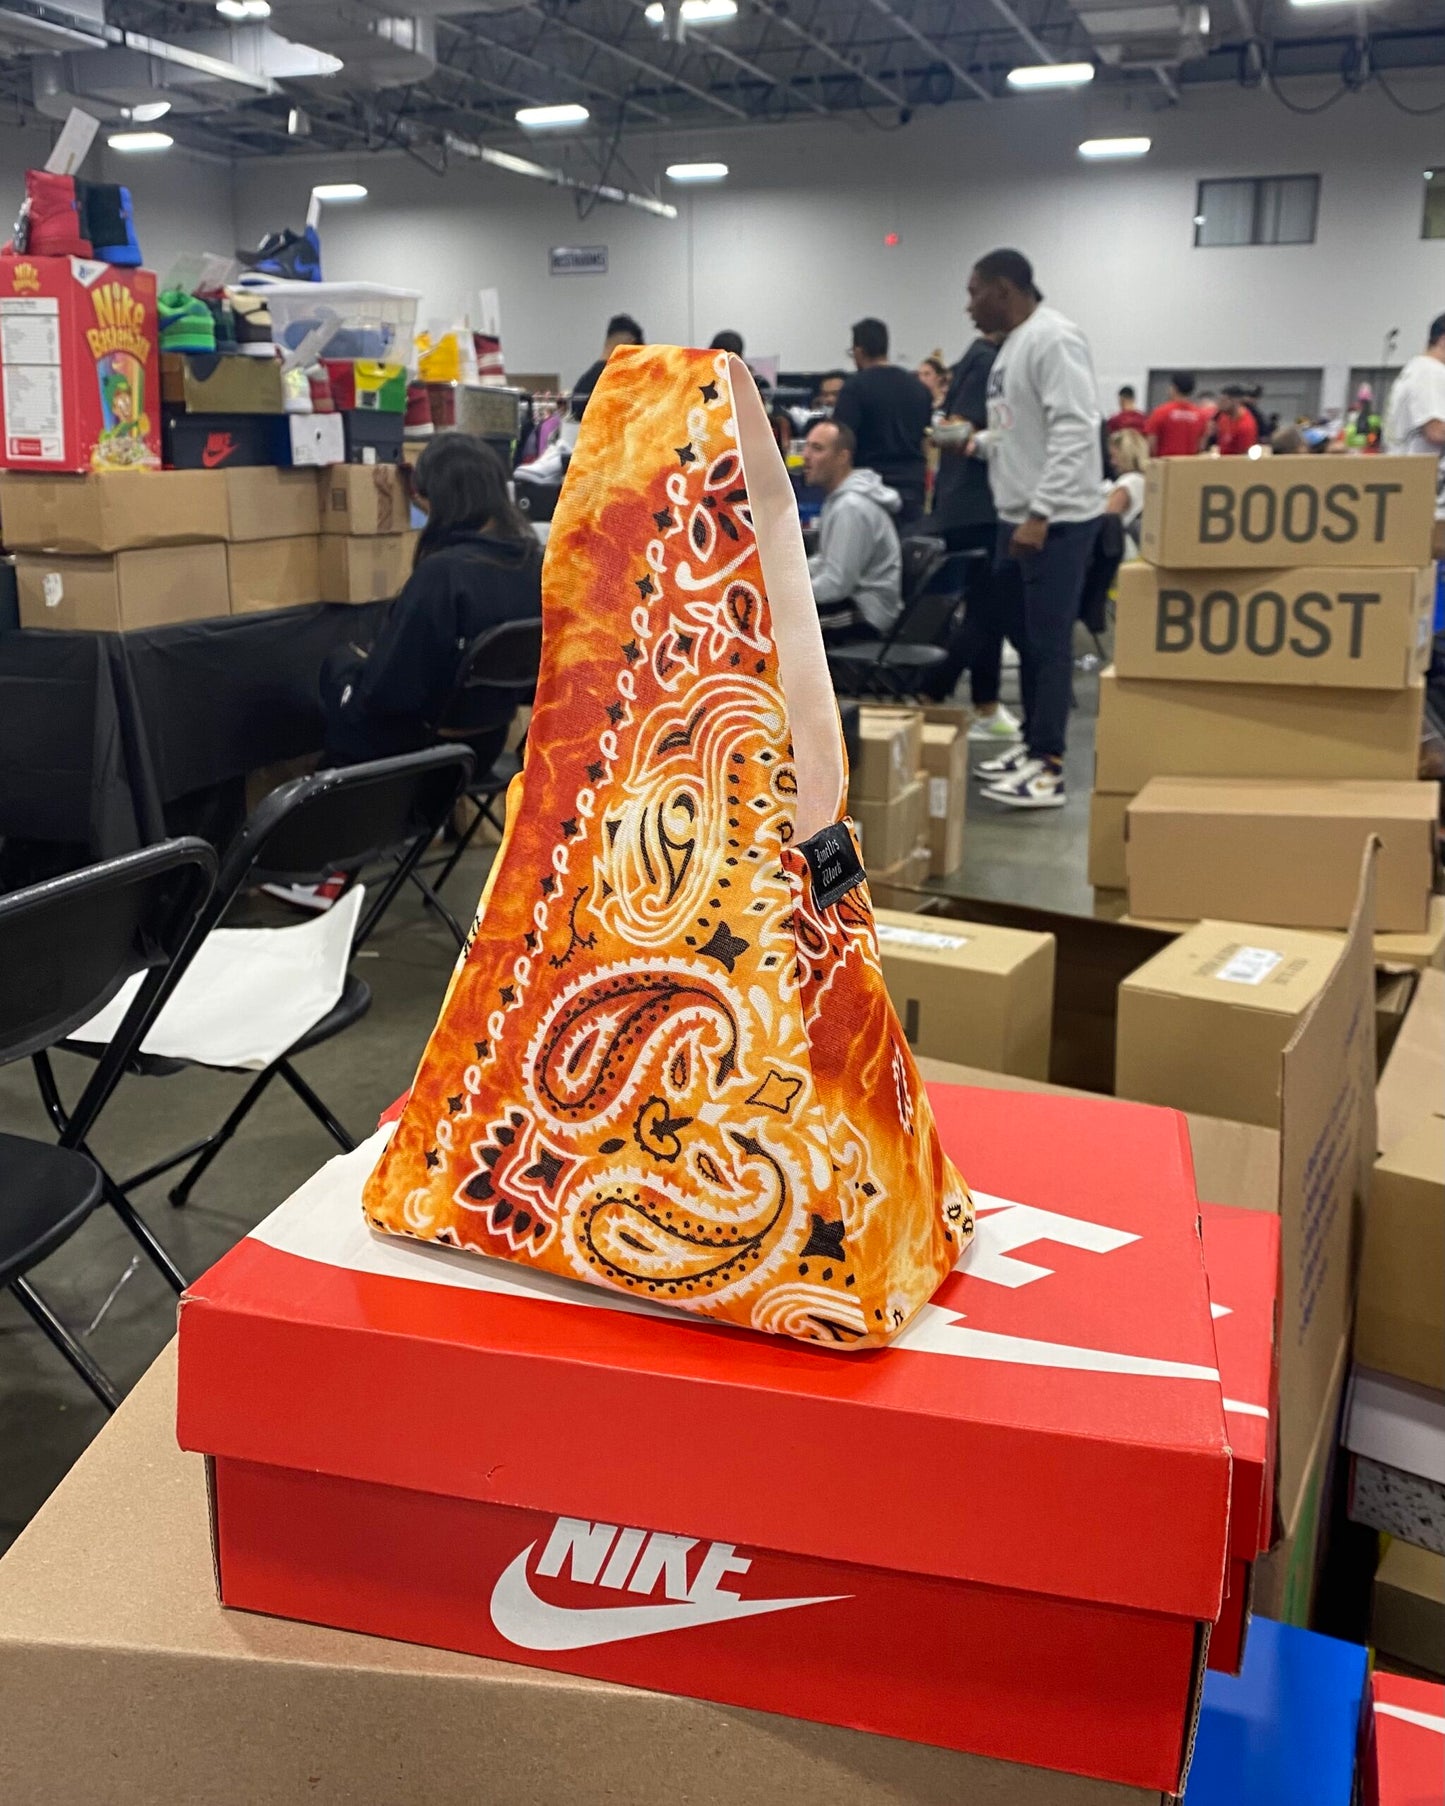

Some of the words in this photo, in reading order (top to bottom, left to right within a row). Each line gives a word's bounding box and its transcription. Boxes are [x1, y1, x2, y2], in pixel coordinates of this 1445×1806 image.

[1199, 483, 1402, 544] BOOST
[1155, 588, 1380, 659] BOOST
[535, 1516, 752, 1603] NIKE
